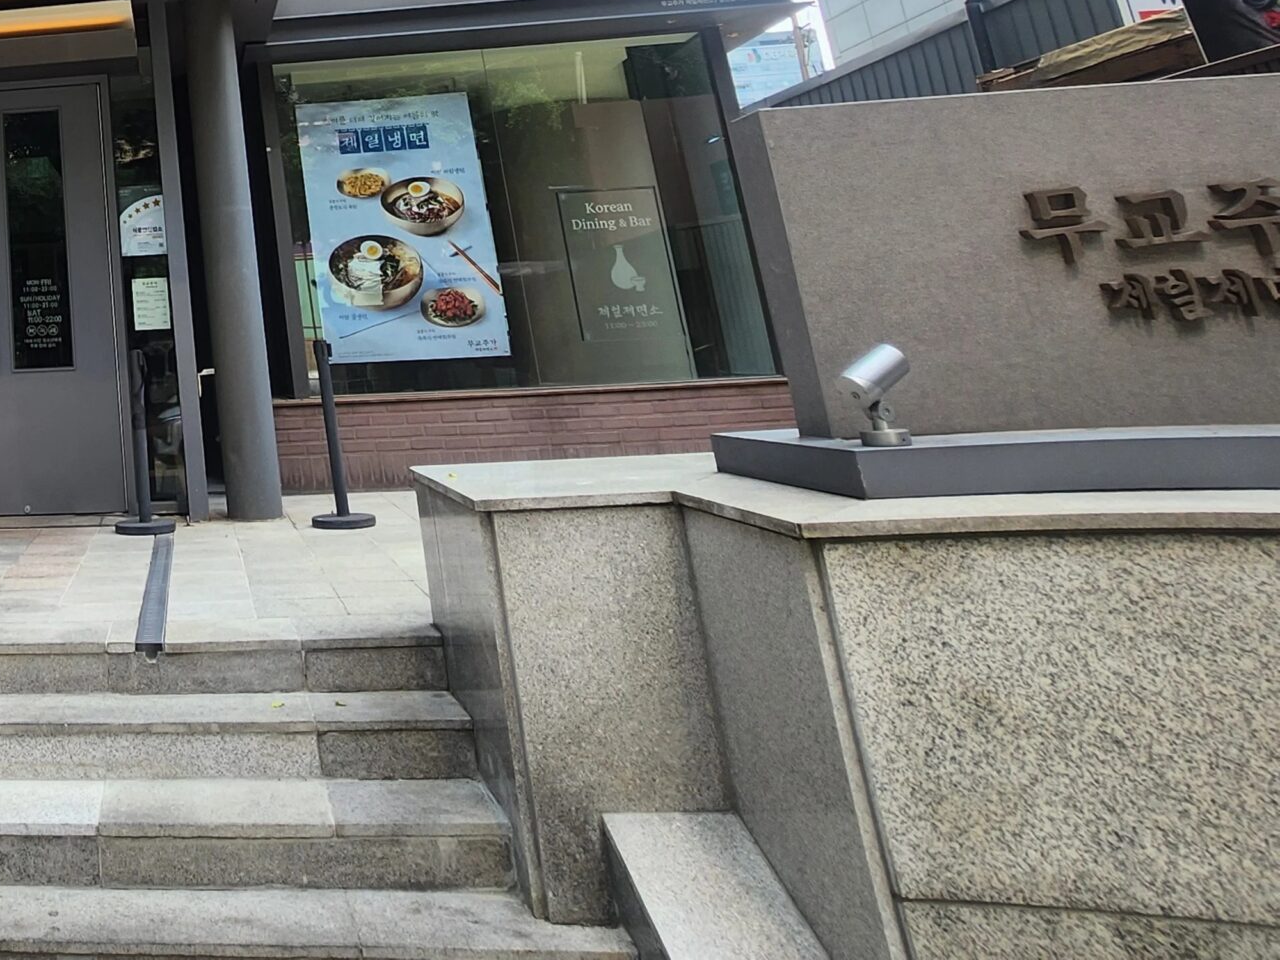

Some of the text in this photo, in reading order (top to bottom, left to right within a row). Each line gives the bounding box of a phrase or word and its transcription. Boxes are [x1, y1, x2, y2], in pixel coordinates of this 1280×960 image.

[339, 128, 428, 152] 제일냉면
[584, 202, 633, 214] Korean
[571, 215, 653, 231] Dining & Bar
[1099, 268, 1280, 321] 제일제
[597, 303, 664, 319] 제일제면소
